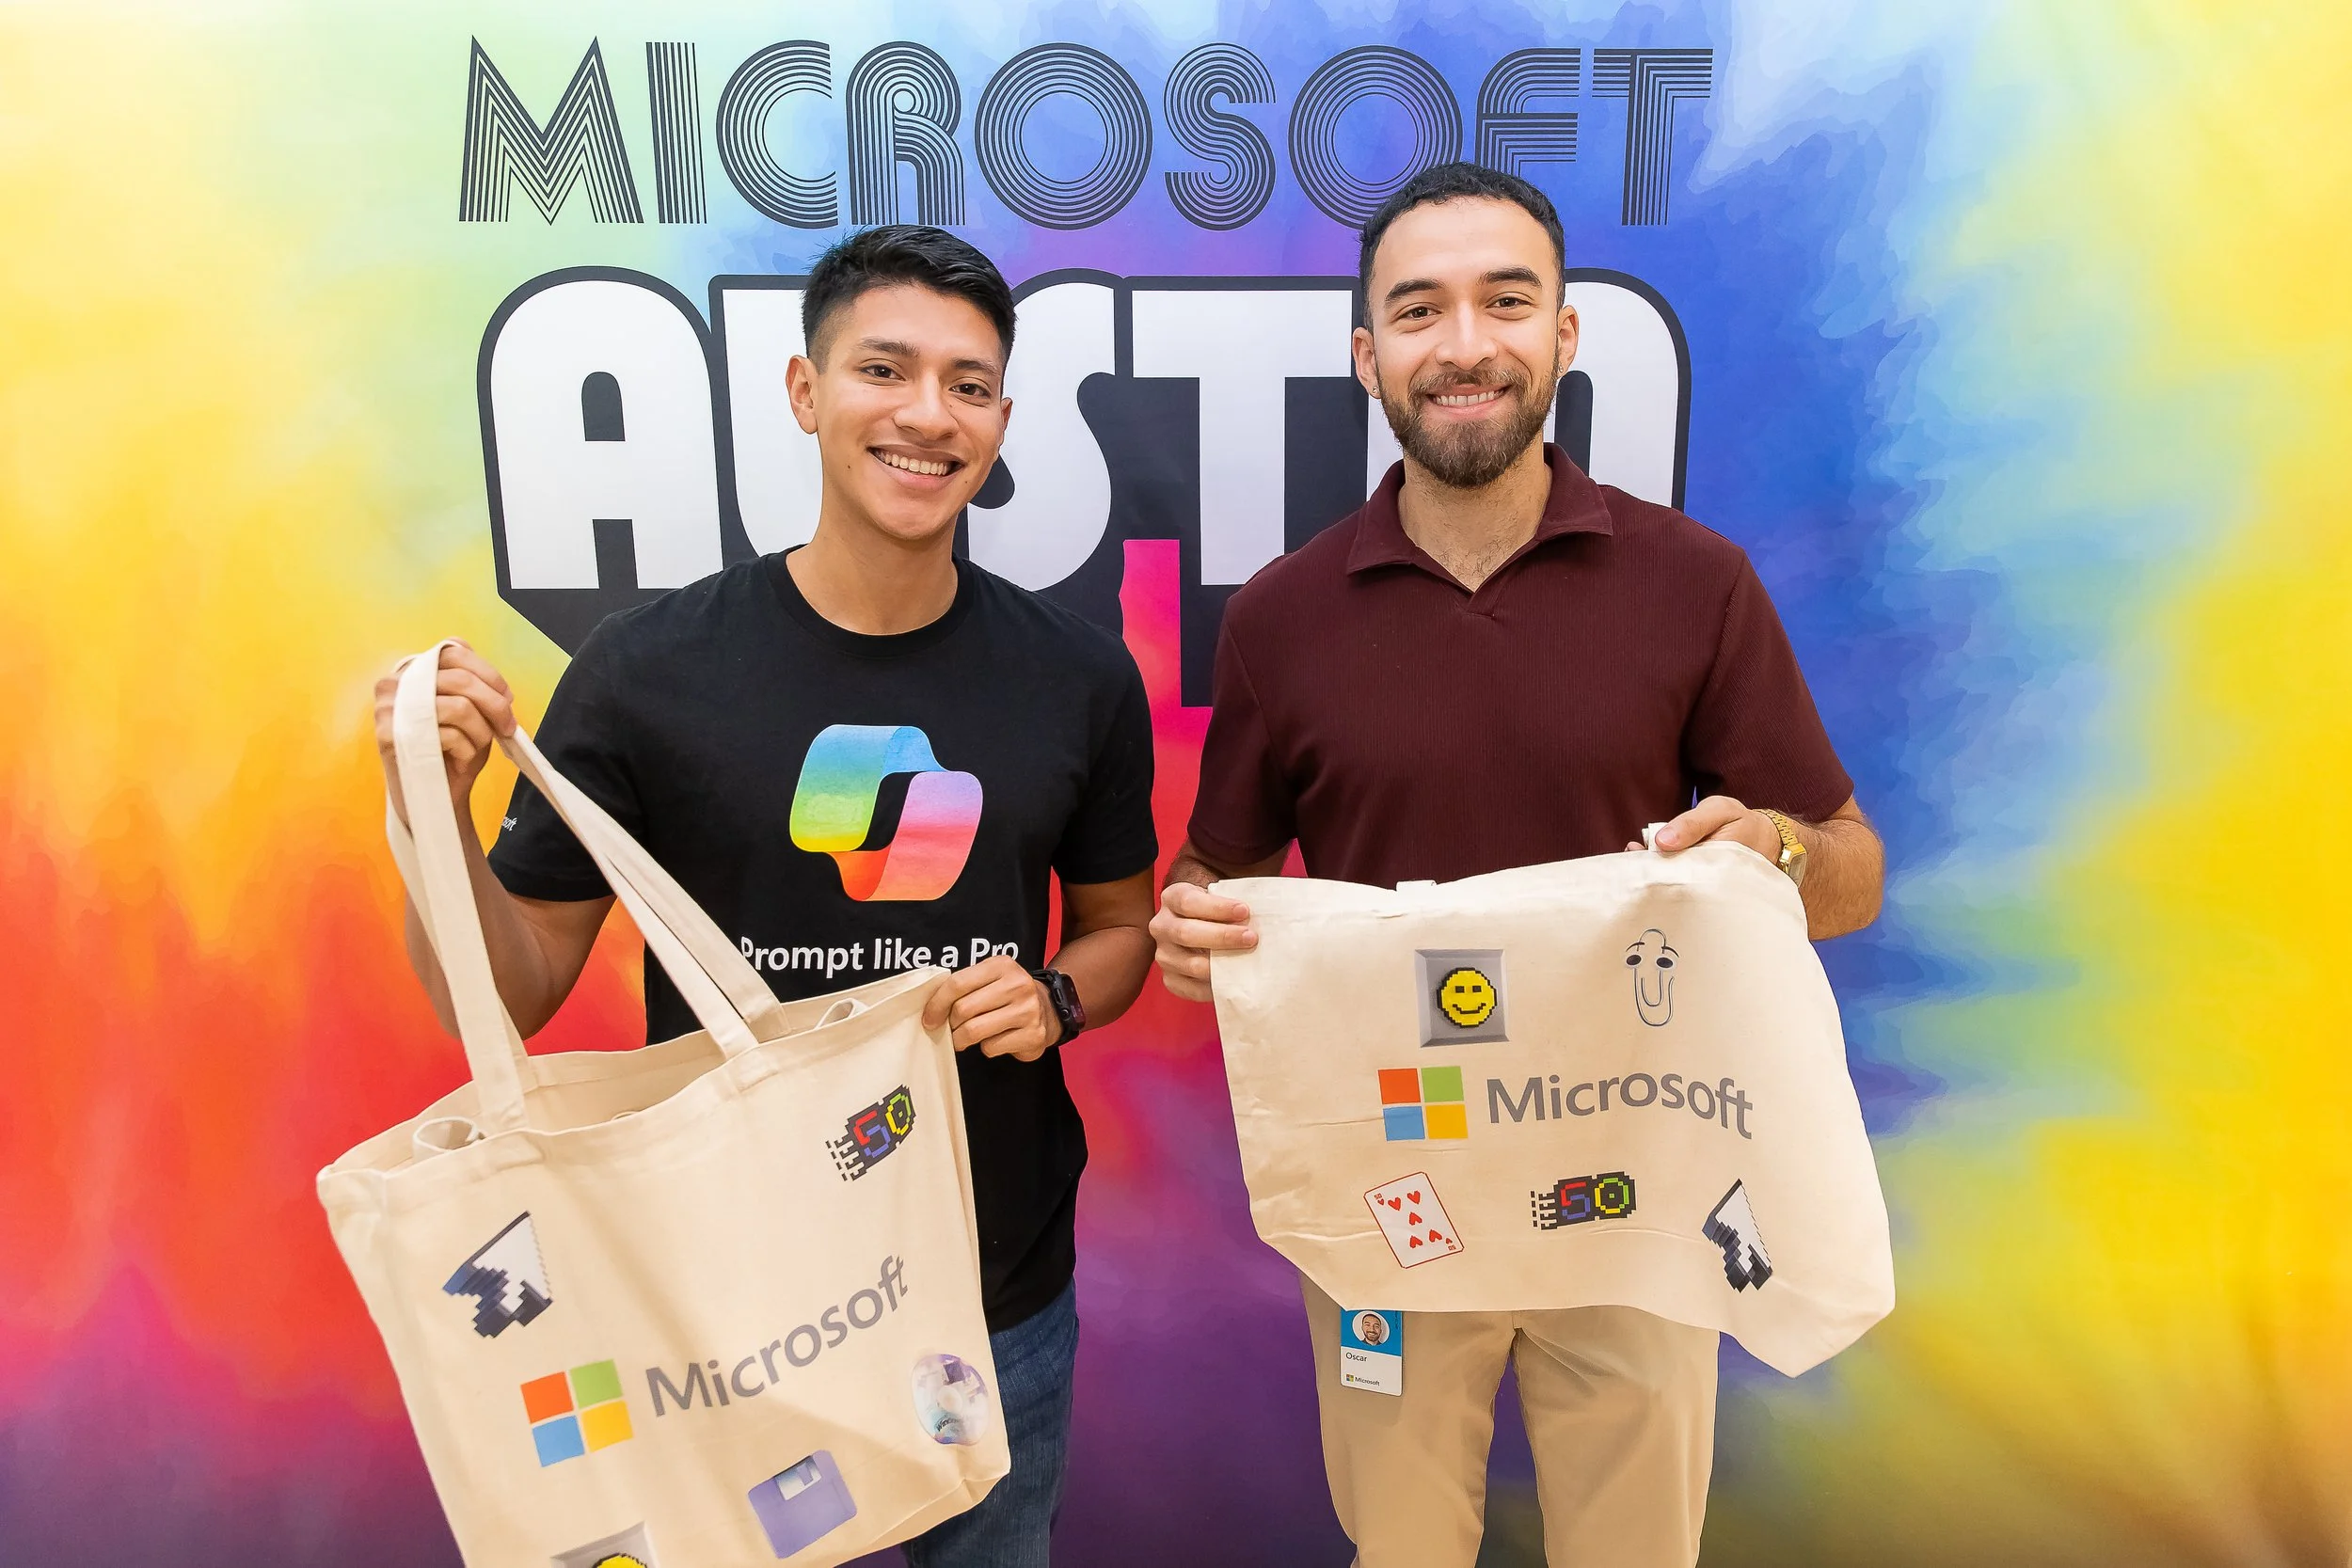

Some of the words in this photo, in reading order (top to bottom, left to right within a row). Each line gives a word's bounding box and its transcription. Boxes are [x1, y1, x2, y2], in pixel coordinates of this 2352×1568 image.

[459, 36, 1713, 231] MICROSOFT
[480, 268, 1690, 597] AST
[740, 936, 865, 979] Prompt
[873, 938, 932, 970] like
[941, 945, 959, 968] a
[1486, 1072, 1754, 1140] Microsoft
[1557, 1174, 1633, 1223] 50
[645, 1255, 909, 1418] Microsoft
[1345, 1352, 1368, 1362] Oscar
[1355, 1376, 1380, 1386] Microsoft
